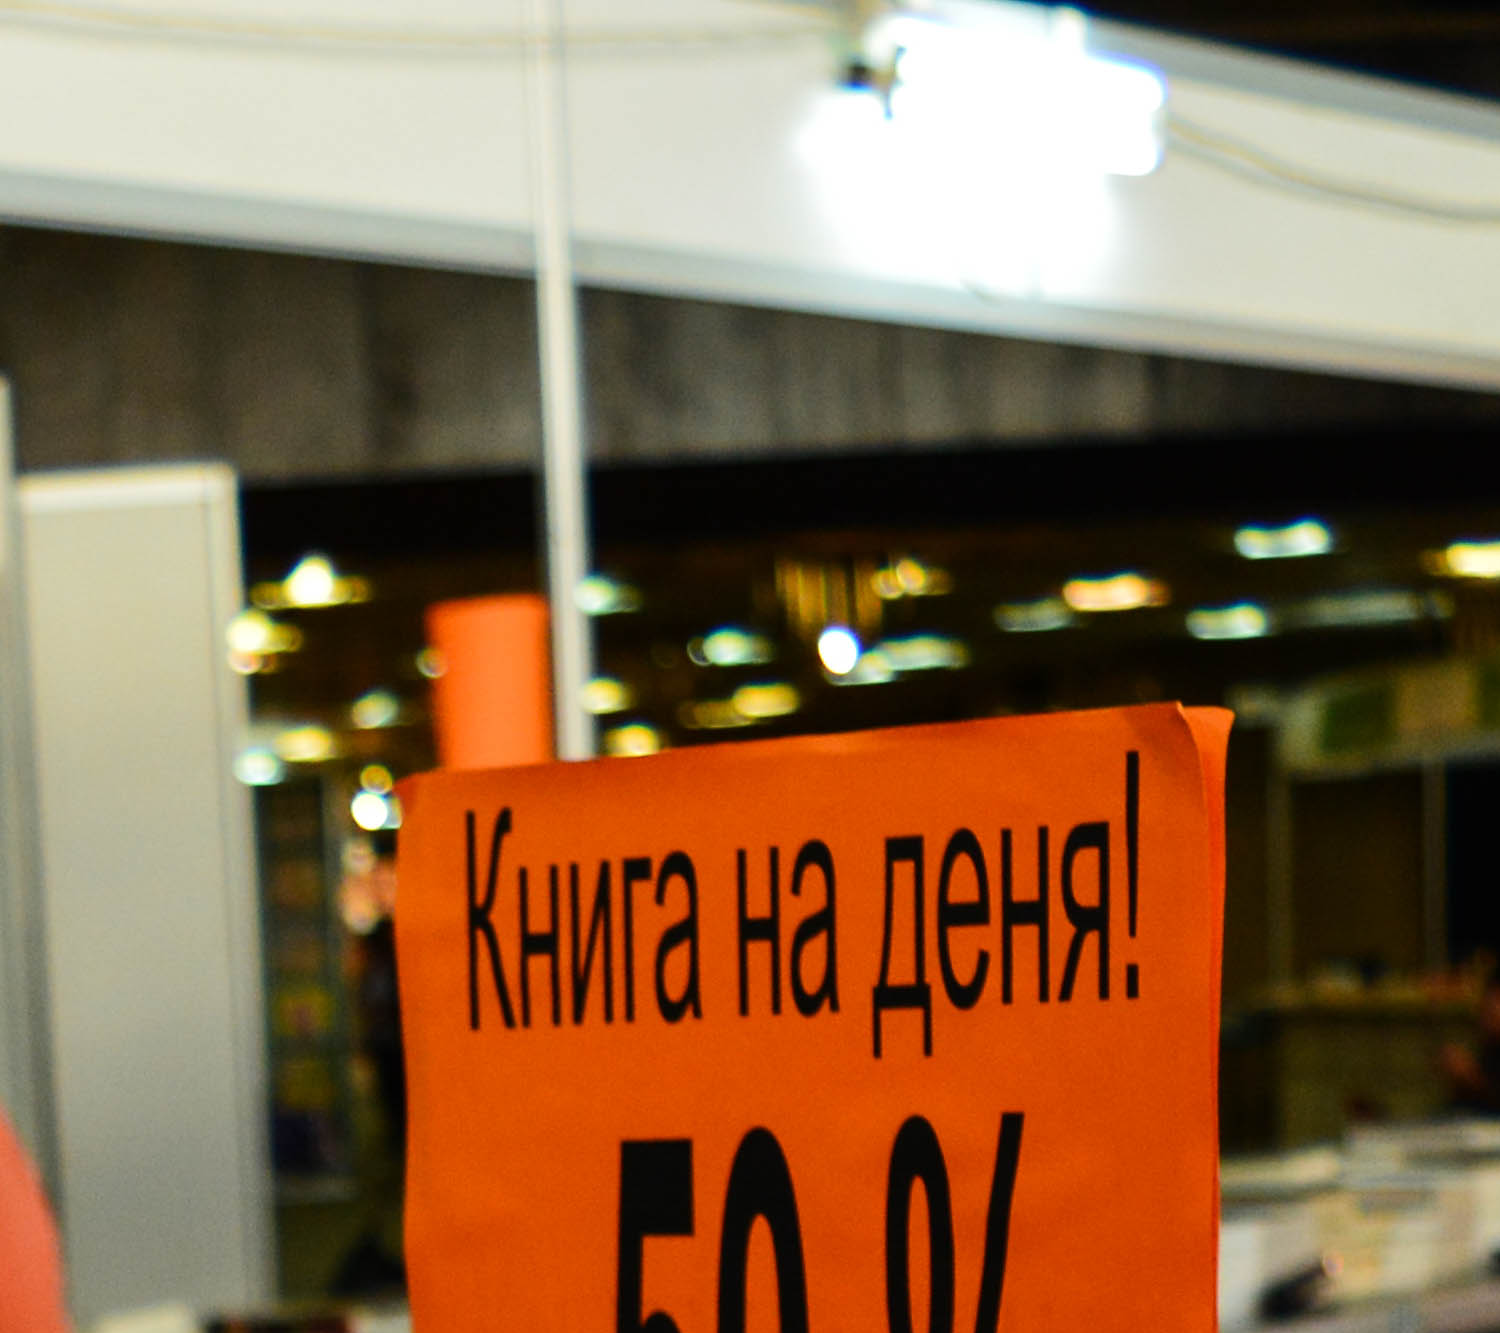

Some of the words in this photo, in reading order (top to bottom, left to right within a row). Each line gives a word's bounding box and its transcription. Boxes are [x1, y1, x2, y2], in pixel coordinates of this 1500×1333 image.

[465, 806, 702, 1031] Книга
[736, 839, 841, 1018] на
[871, 750, 1141, 1060] деня!
